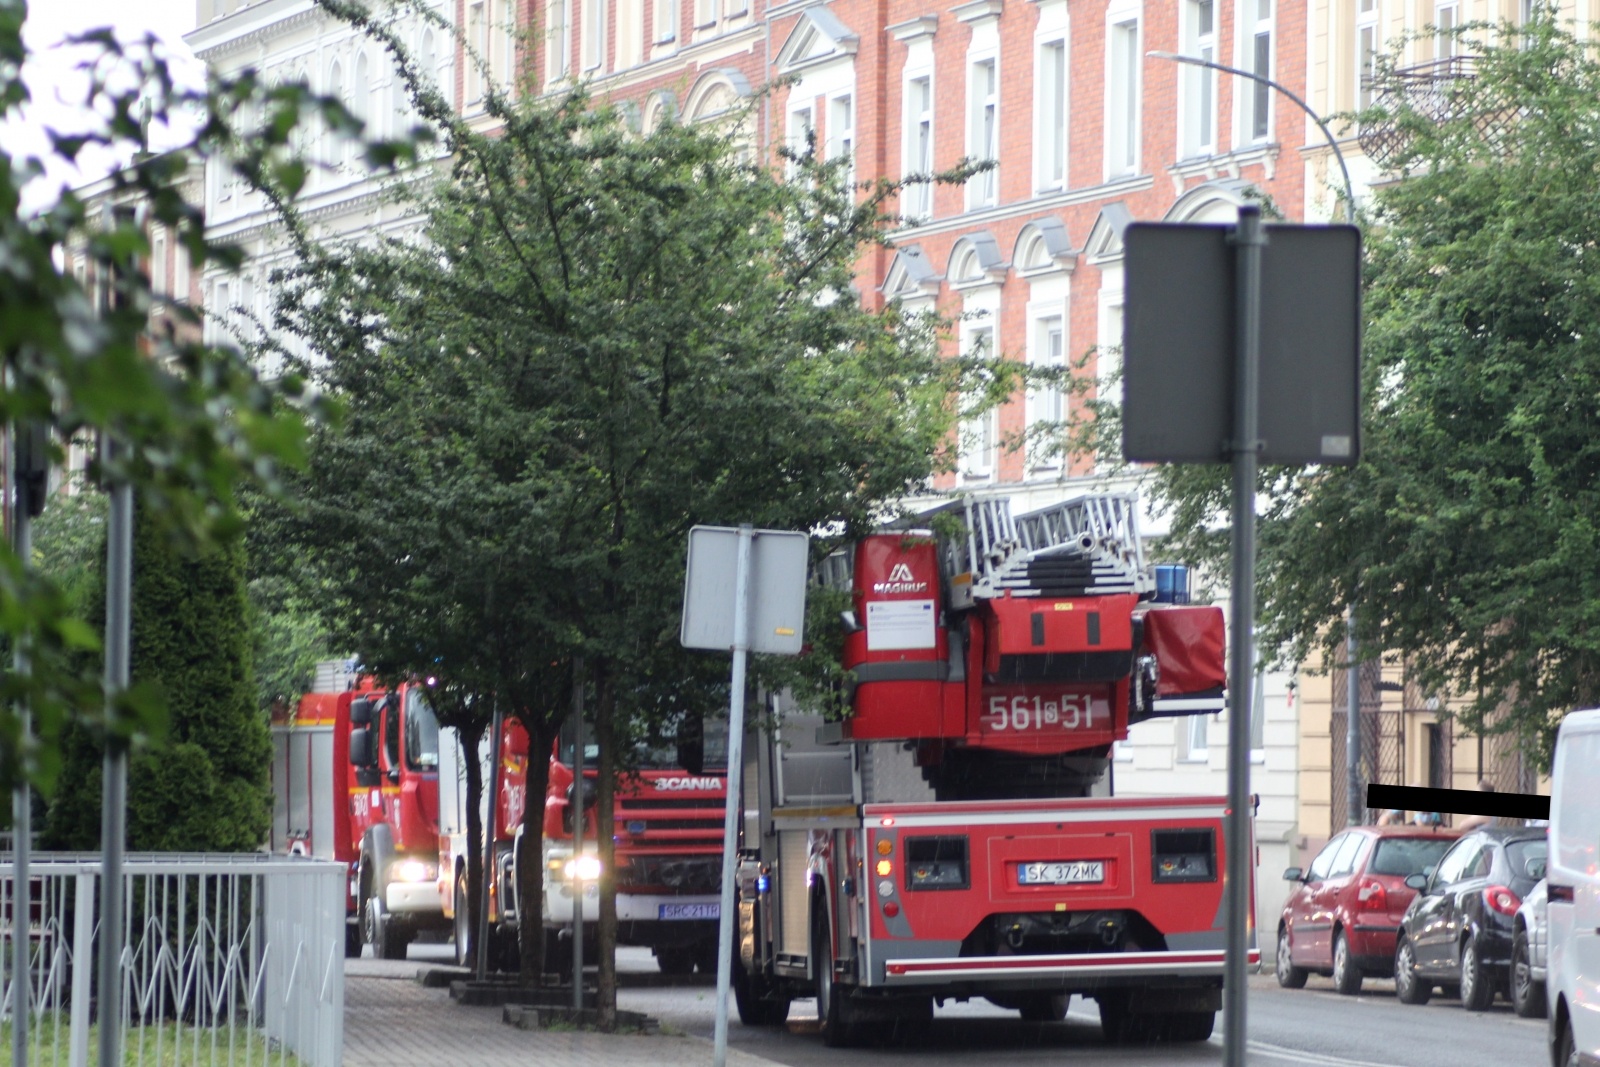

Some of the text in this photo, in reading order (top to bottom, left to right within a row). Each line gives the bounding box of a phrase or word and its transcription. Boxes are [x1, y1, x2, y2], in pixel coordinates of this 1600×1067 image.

[873, 582, 927, 594] MAGIRUS
[655, 777, 722, 791] SCANIA
[1028, 863, 1100, 881] SK 372MK
